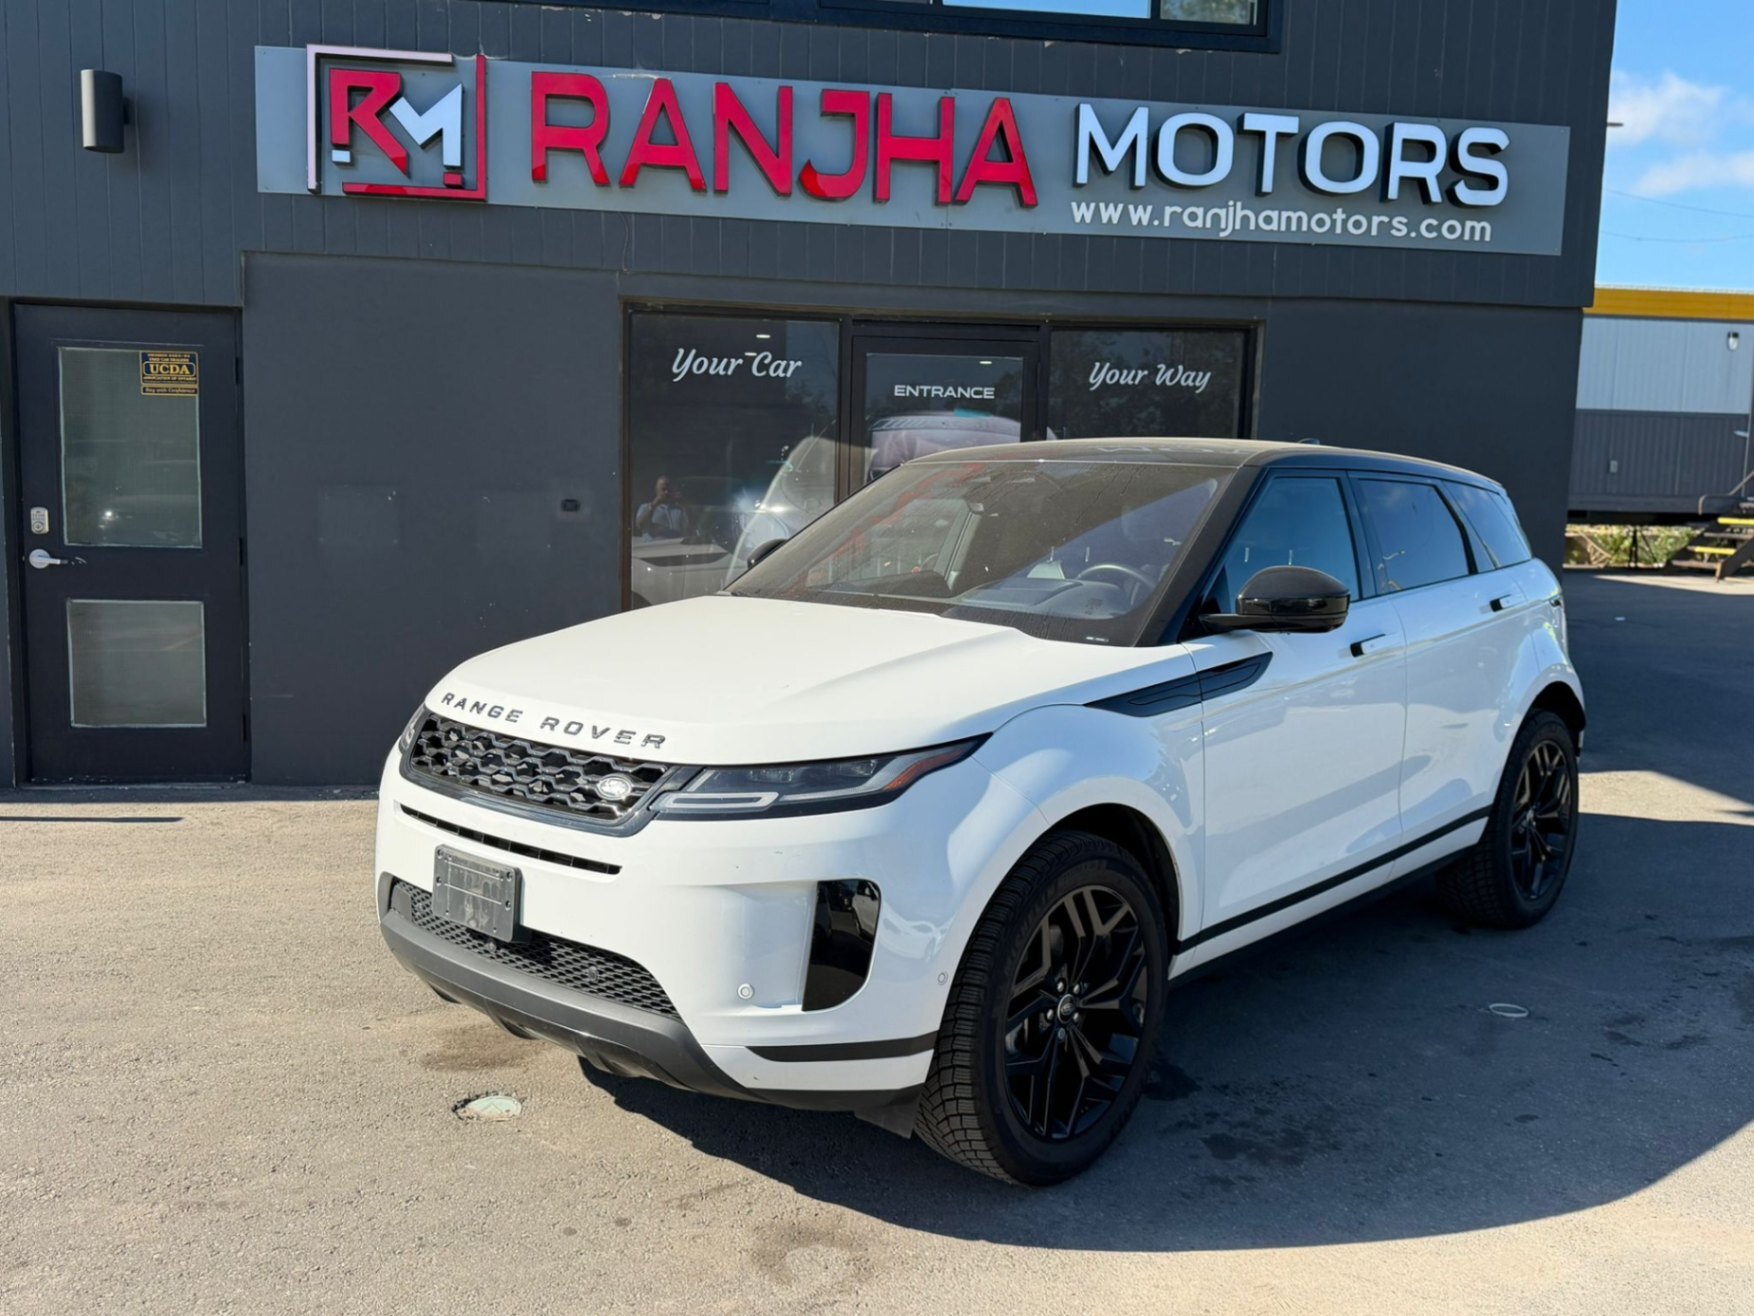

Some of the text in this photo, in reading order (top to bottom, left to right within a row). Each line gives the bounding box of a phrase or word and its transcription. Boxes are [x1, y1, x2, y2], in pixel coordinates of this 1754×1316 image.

[531, 71, 1511, 207] RANJHA MOTORS
[1071, 200, 1492, 242] www.ranjhamotors.com
[150, 363, 190, 375] UCDA
[672, 347, 803, 382] Your Car
[1089, 362, 1212, 393] Your Way
[893, 384, 996, 399] ENTRANCE
[441, 692, 666, 750] RANGE ROVER
